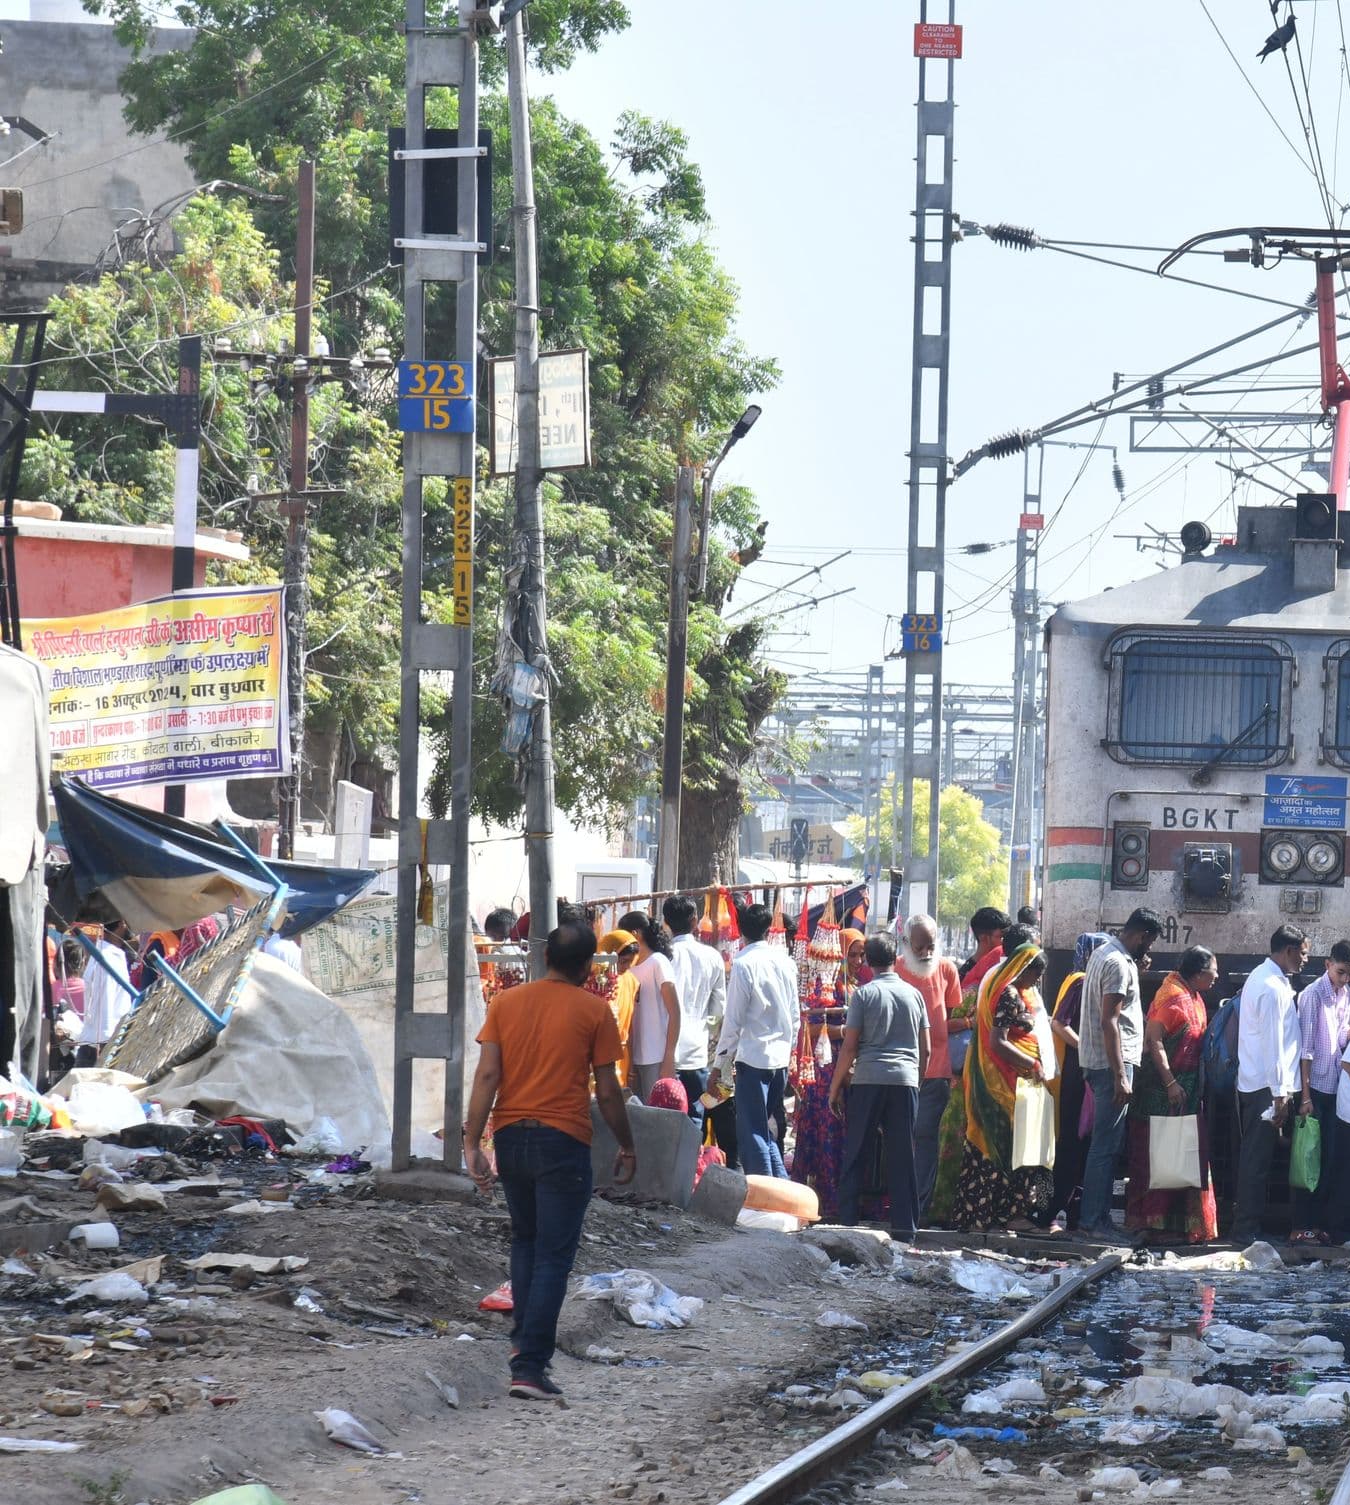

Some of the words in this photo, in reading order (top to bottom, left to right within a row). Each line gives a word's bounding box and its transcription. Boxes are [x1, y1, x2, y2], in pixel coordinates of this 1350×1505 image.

[918, 48, 958, 56] RESTRICTED
[409, 363, 465, 394] 323
[424, 399, 451, 430] 15
[457, 484, 471, 553] 323
[455, 571, 469, 618] 15
[106, 626, 145, 660] हनुमान
[145, 617, 161, 648] जी
[173, 612, 220, 644] असीम
[259, 605, 275, 635] से
[908, 614, 937, 632] 323
[914, 632, 930, 650] 16
[72, 666, 103, 689] विशाल
[95, 695, 110, 711] 16
[111, 690, 148, 712] अक्टूबर
[190, 683, 217, 698] वार
[217, 678, 266, 701] बुधवार
[198, 711, 217, 726] 7:30
[173, 736, 206, 752] गली,
[210, 730, 261, 749] बीकानेर
[1163, 806, 1240, 832] BGKT
[1279, 805, 1303, 817] अमृत
[1304, 804, 1341, 817] महोत्सव
[1182, 925, 1193, 944] 7
